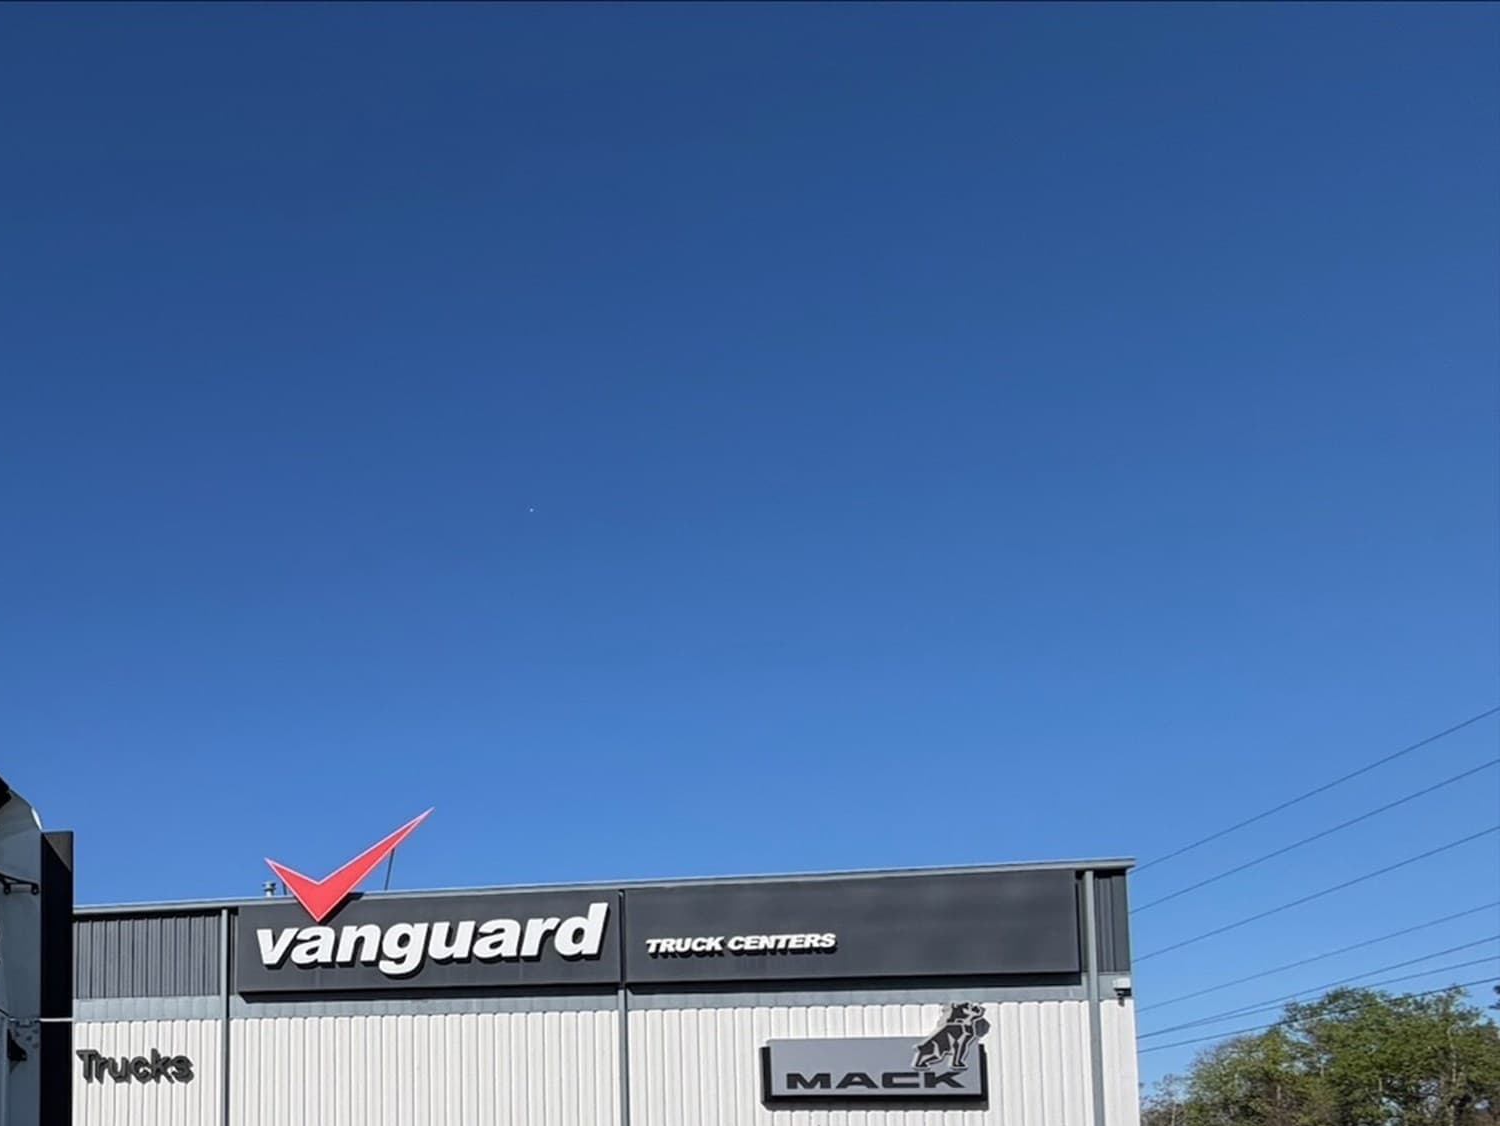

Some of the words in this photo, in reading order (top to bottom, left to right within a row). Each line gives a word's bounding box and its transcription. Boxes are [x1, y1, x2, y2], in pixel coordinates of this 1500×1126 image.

[257, 902, 609, 975] vanguard
[646, 936, 725, 953] TRUCK
[727, 933, 837, 951] CENTERS
[76, 1048, 194, 1084] Trucks
[786, 1072, 965, 1089] MACK
